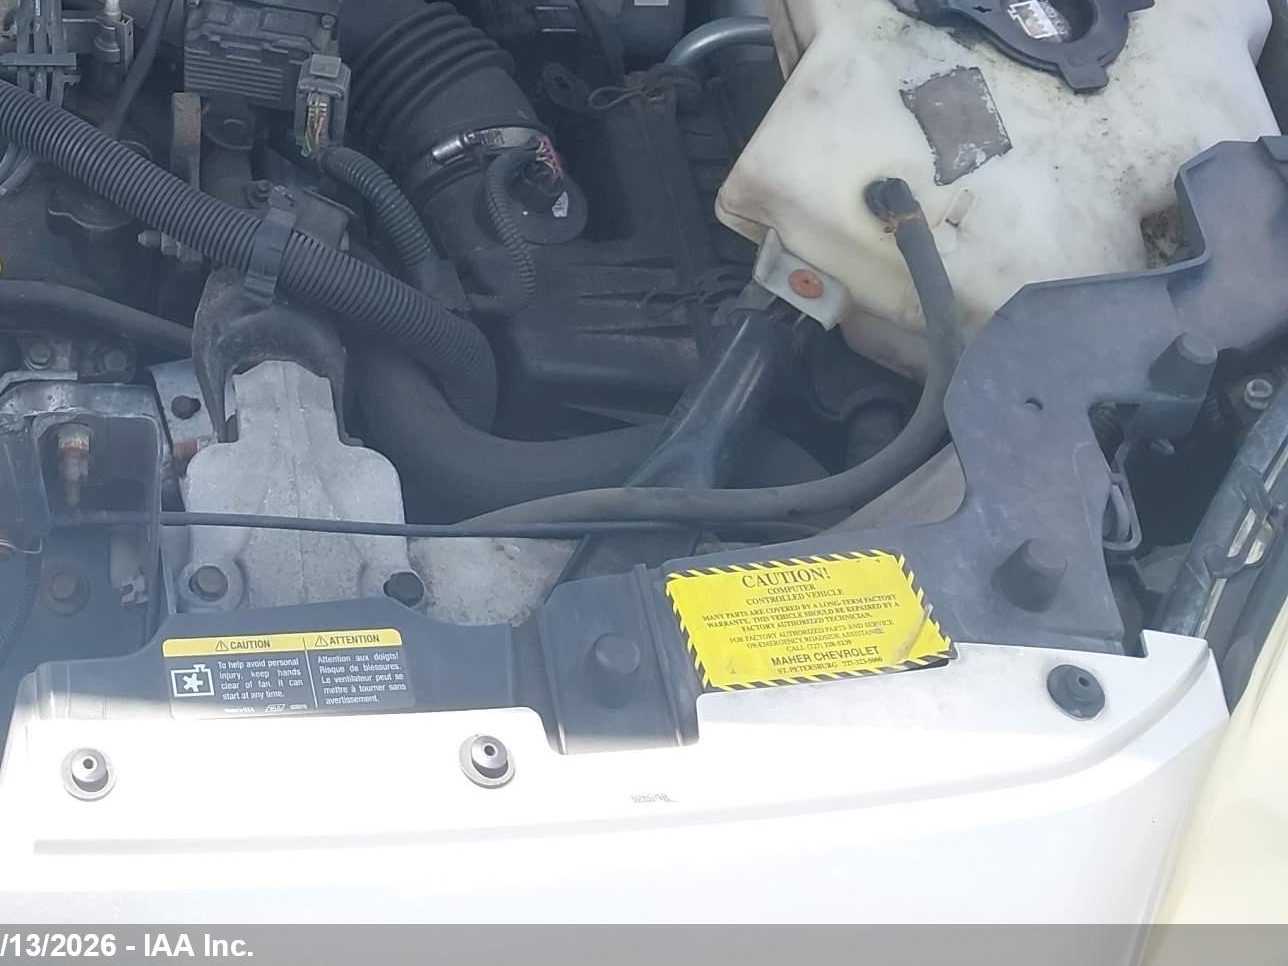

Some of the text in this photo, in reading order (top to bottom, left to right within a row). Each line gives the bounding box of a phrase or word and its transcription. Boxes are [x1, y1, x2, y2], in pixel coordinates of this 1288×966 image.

[742, 567, 830, 588] CAUTION!
[768, 584, 816, 594] COMPUTER
[746, 588, 844, 605] CONTROLLED VEHICLE
[703, 612, 725, 621] MANY
[726, 610, 748, 619] PARTS
[766, 605, 800, 614] COVERED
[865, 594, 896, 603] FACTORY
[752, 616, 769, 624] THIS
[770, 612, 804, 622] VEHICLE
[804, 609, 834, 617] SHOULD
[847, 604, 882, 612] REPAIRED
[741, 624, 775, 632] FACTORY
[776, 618, 824, 629] AUTHORIZED
[745, 633, 777, 642] FACTORY
[780, 627, 824, 638] AUTHORIZED
[825, 625, 847, 633] PARTS
[865, 619, 894, 628] SERVICE
[230, 634, 380, 649] CAUTION ATTENTION
[318, 655, 351, 663] Attention
[374, 652, 398, 661] doigts!
[771, 646, 879, 666] MAHER CHEVROLET
[228, 660, 244, 670] help
[246, 659, 266, 668] avoid
[268, 658, 299, 667] personal
[320, 665, 344, 674] Risque
[220, 668, 301, 680] injury, keep hands
[321, 676, 331, 684] Le
[334, 674, 372, 683] ventilateur
[375, 673, 391, 682] peut
[221, 682, 239, 690] clear
[246, 681, 252, 689] of
[324, 686, 348, 694] mettre
[352, 685, 356, 693] à
[359, 684, 385, 692] tourner
[251, 692, 264, 700] any
[266, 690, 284, 698] time.
